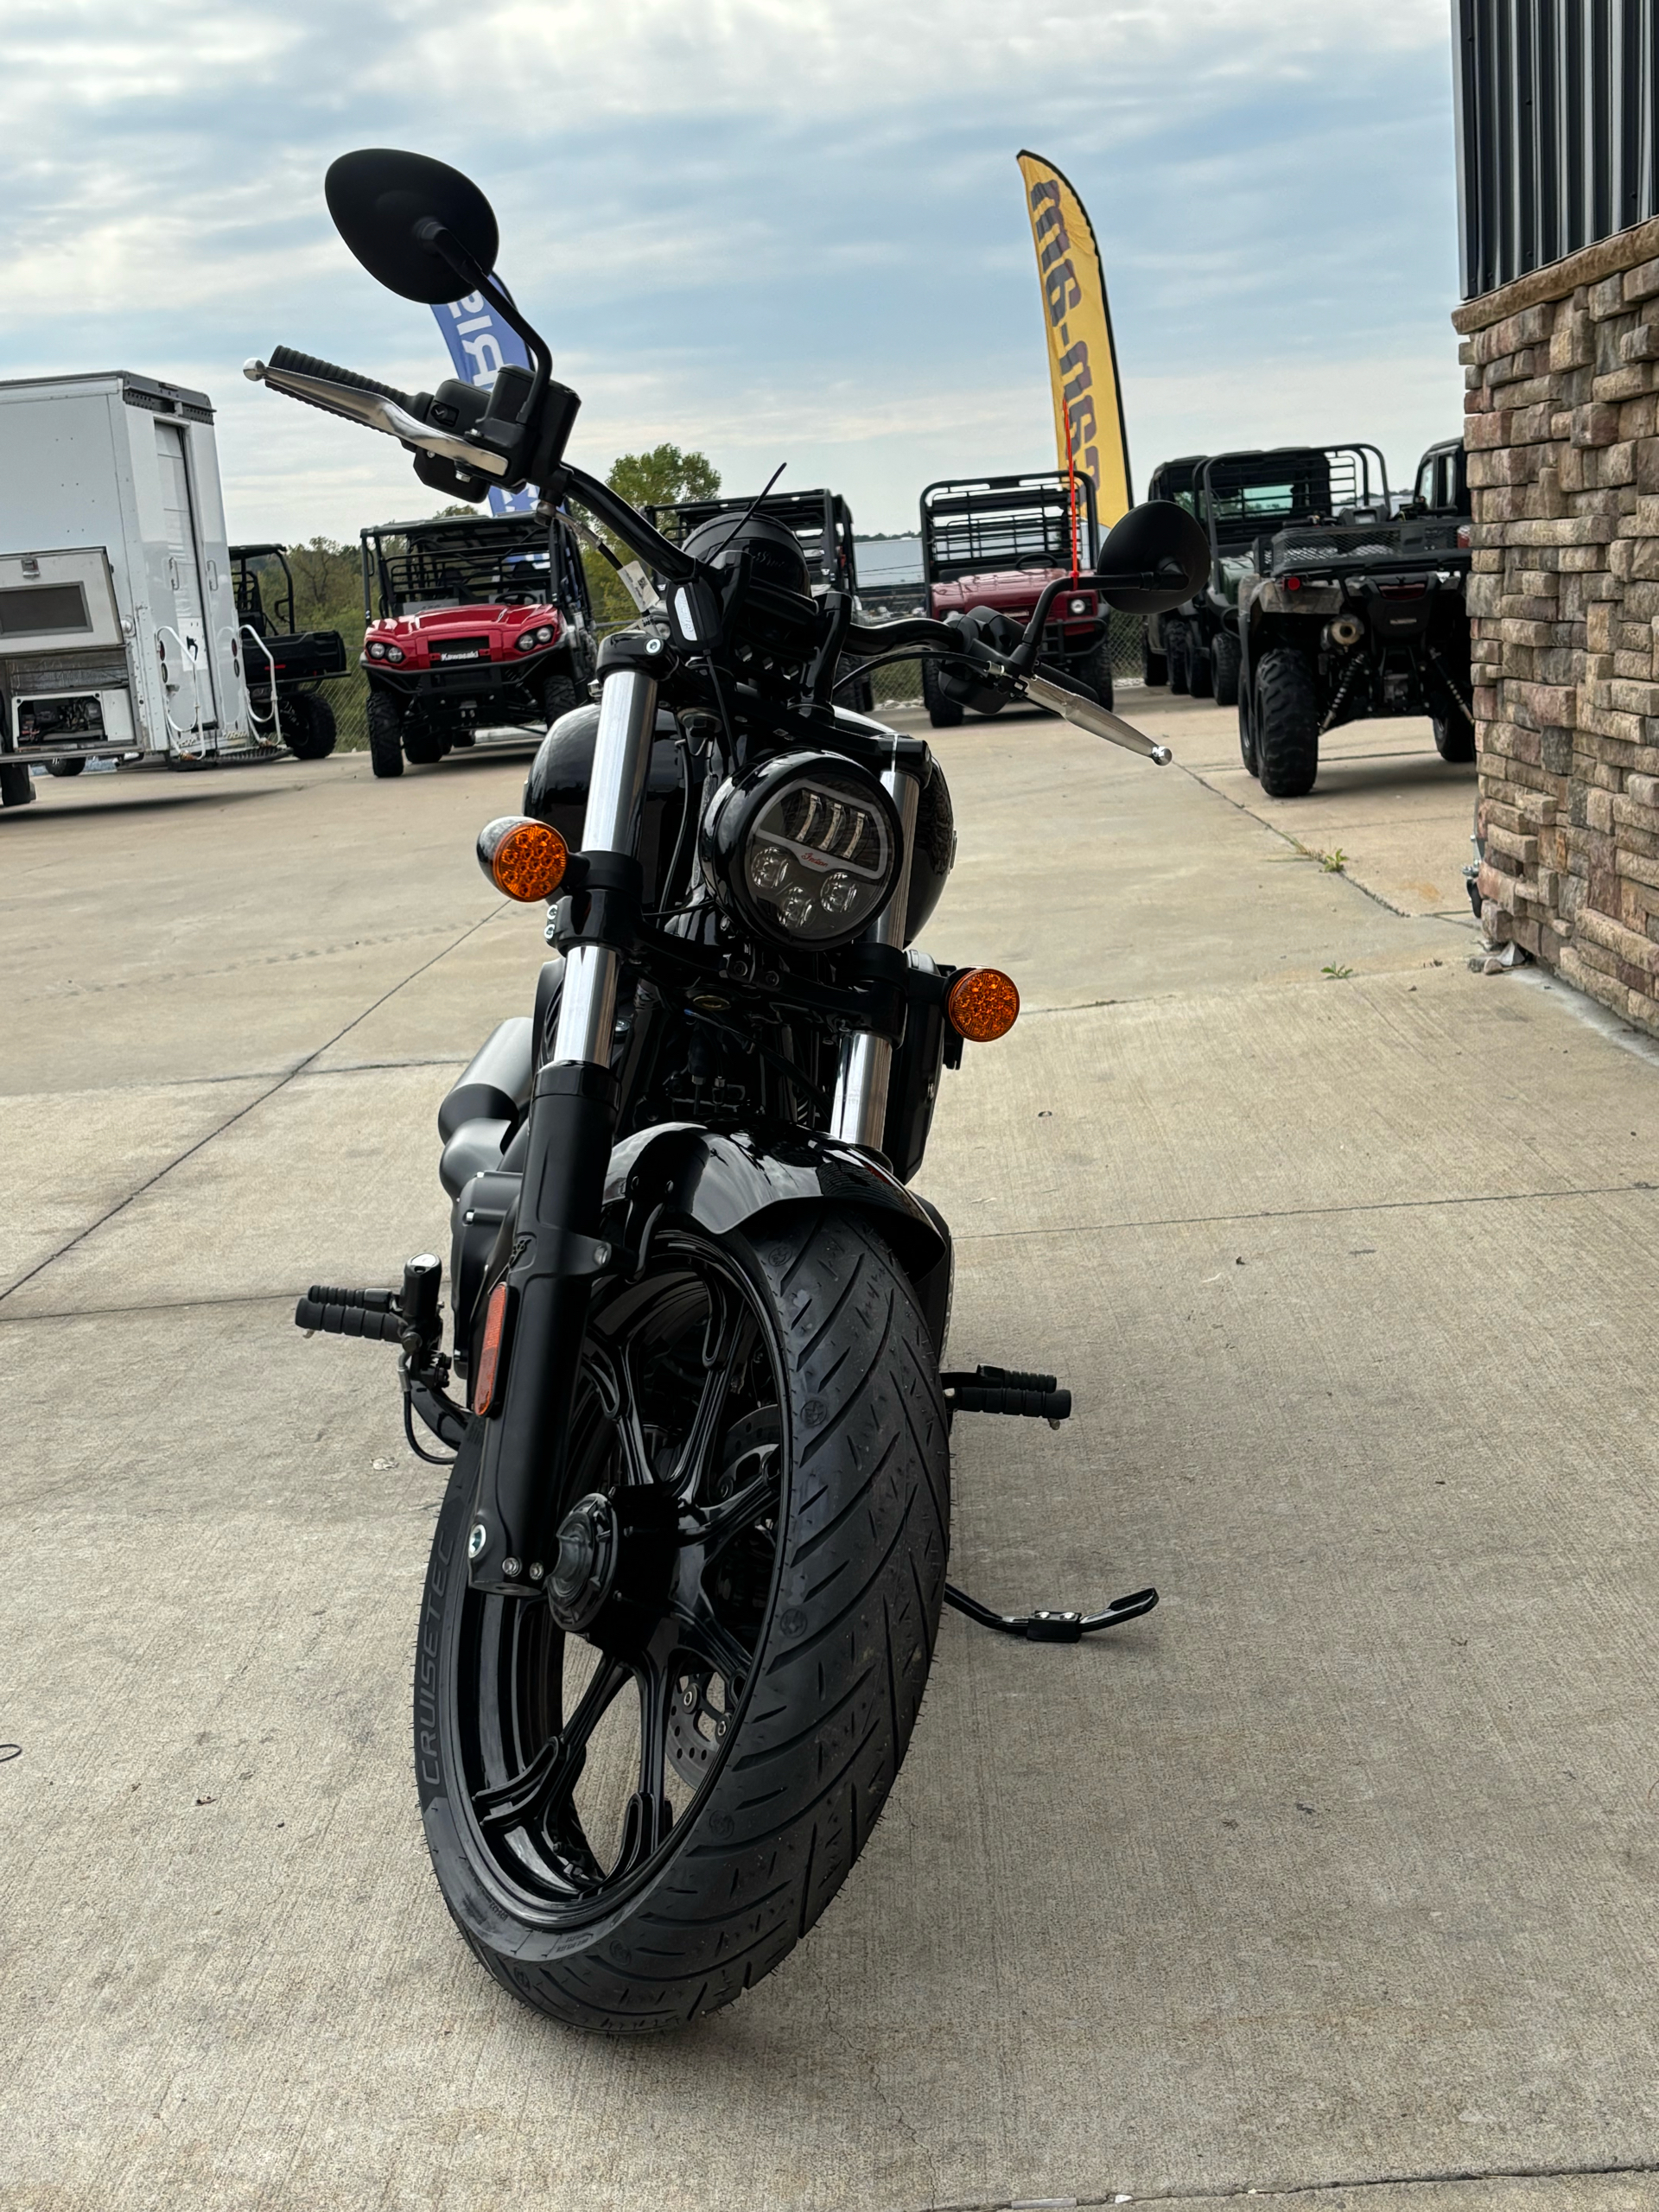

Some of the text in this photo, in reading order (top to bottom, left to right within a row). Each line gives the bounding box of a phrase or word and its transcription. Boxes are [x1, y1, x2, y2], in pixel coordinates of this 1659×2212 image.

[441, 651, 479, 661] Kawasaki
[801, 852, 829, 867] Indian
[420, 1530, 454, 1786] CRUISETEC
